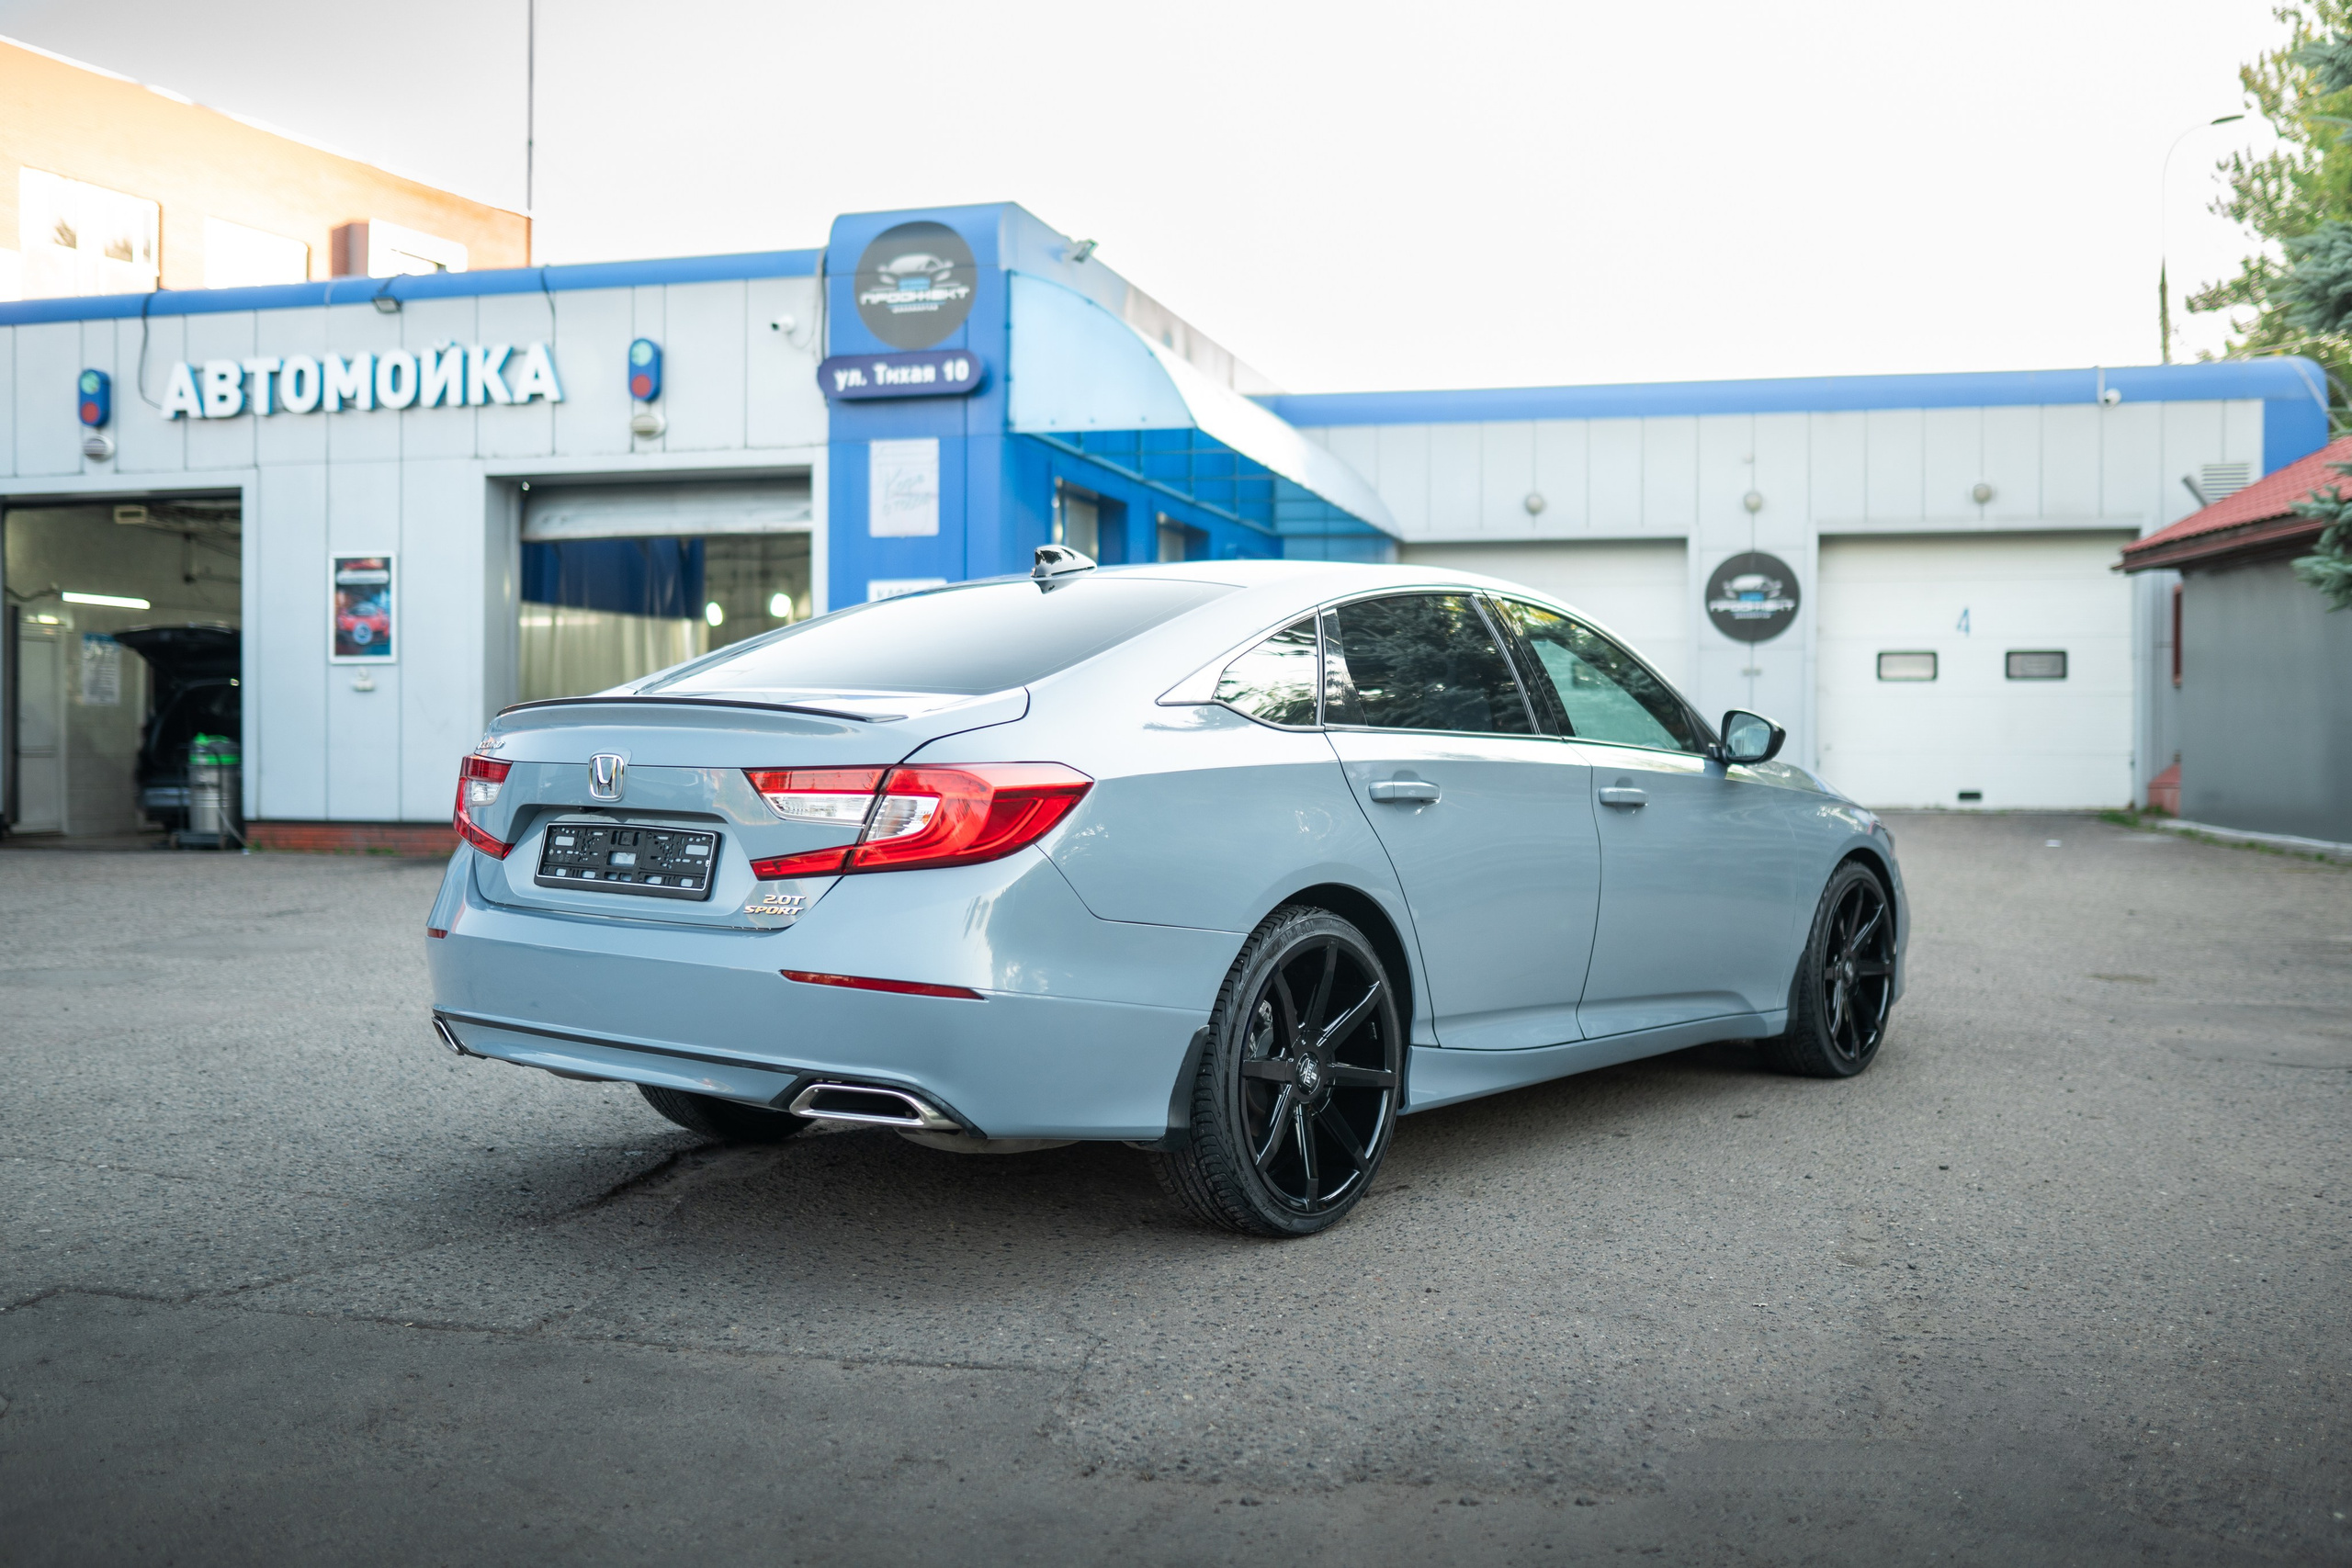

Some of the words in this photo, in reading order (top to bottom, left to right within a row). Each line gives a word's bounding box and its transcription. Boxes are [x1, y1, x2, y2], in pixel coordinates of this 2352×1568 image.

[160, 339, 564, 420] АВТОМОЙКА
[834, 368, 867, 392] ул.
[873, 362, 936, 386] Тихая
[943, 357, 969, 382] 10
[1956, 607, 1970, 637] 4
[743, 905, 805, 915] SPORT
[763, 894, 806, 906] 2.0T
